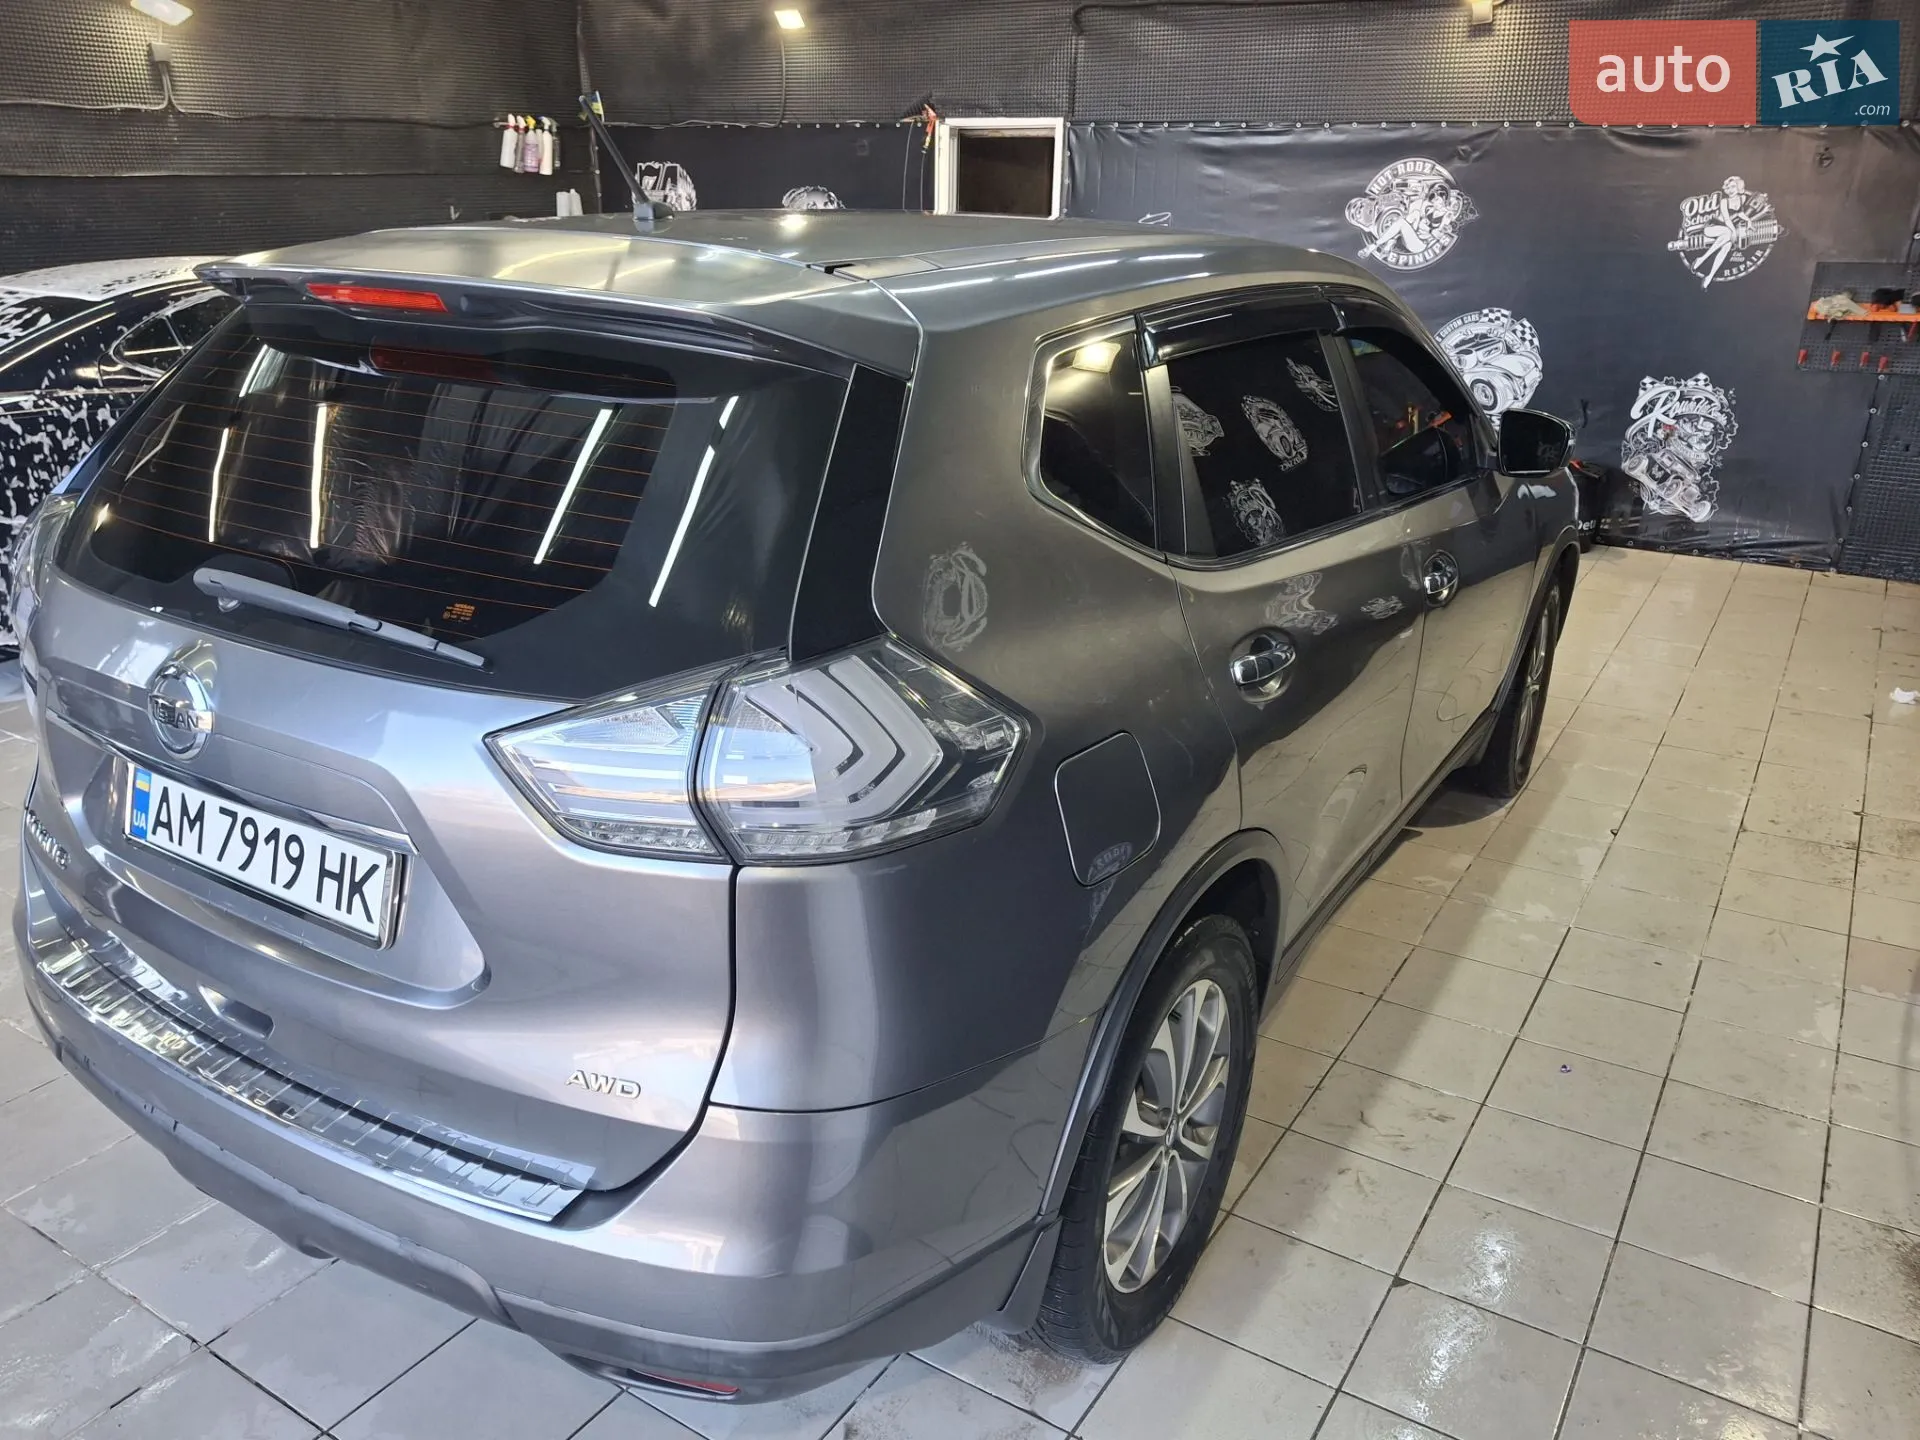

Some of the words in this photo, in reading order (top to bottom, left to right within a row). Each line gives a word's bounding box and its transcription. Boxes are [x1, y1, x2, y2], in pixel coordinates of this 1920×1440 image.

[1369, 169, 1393, 195] HOT
[1397, 161, 1433, 175] RODZ
[1682, 193, 1720, 217] Old
[1723, 249, 1764, 277] REPAIR
[1463, 313, 1480, 323] CARS
[133, 808, 147, 829] UA
[151, 786, 206, 855] AM
[216, 806, 305, 890] 7919
[316, 844, 380, 924] HK
[565, 1069, 642, 1100] AWD
